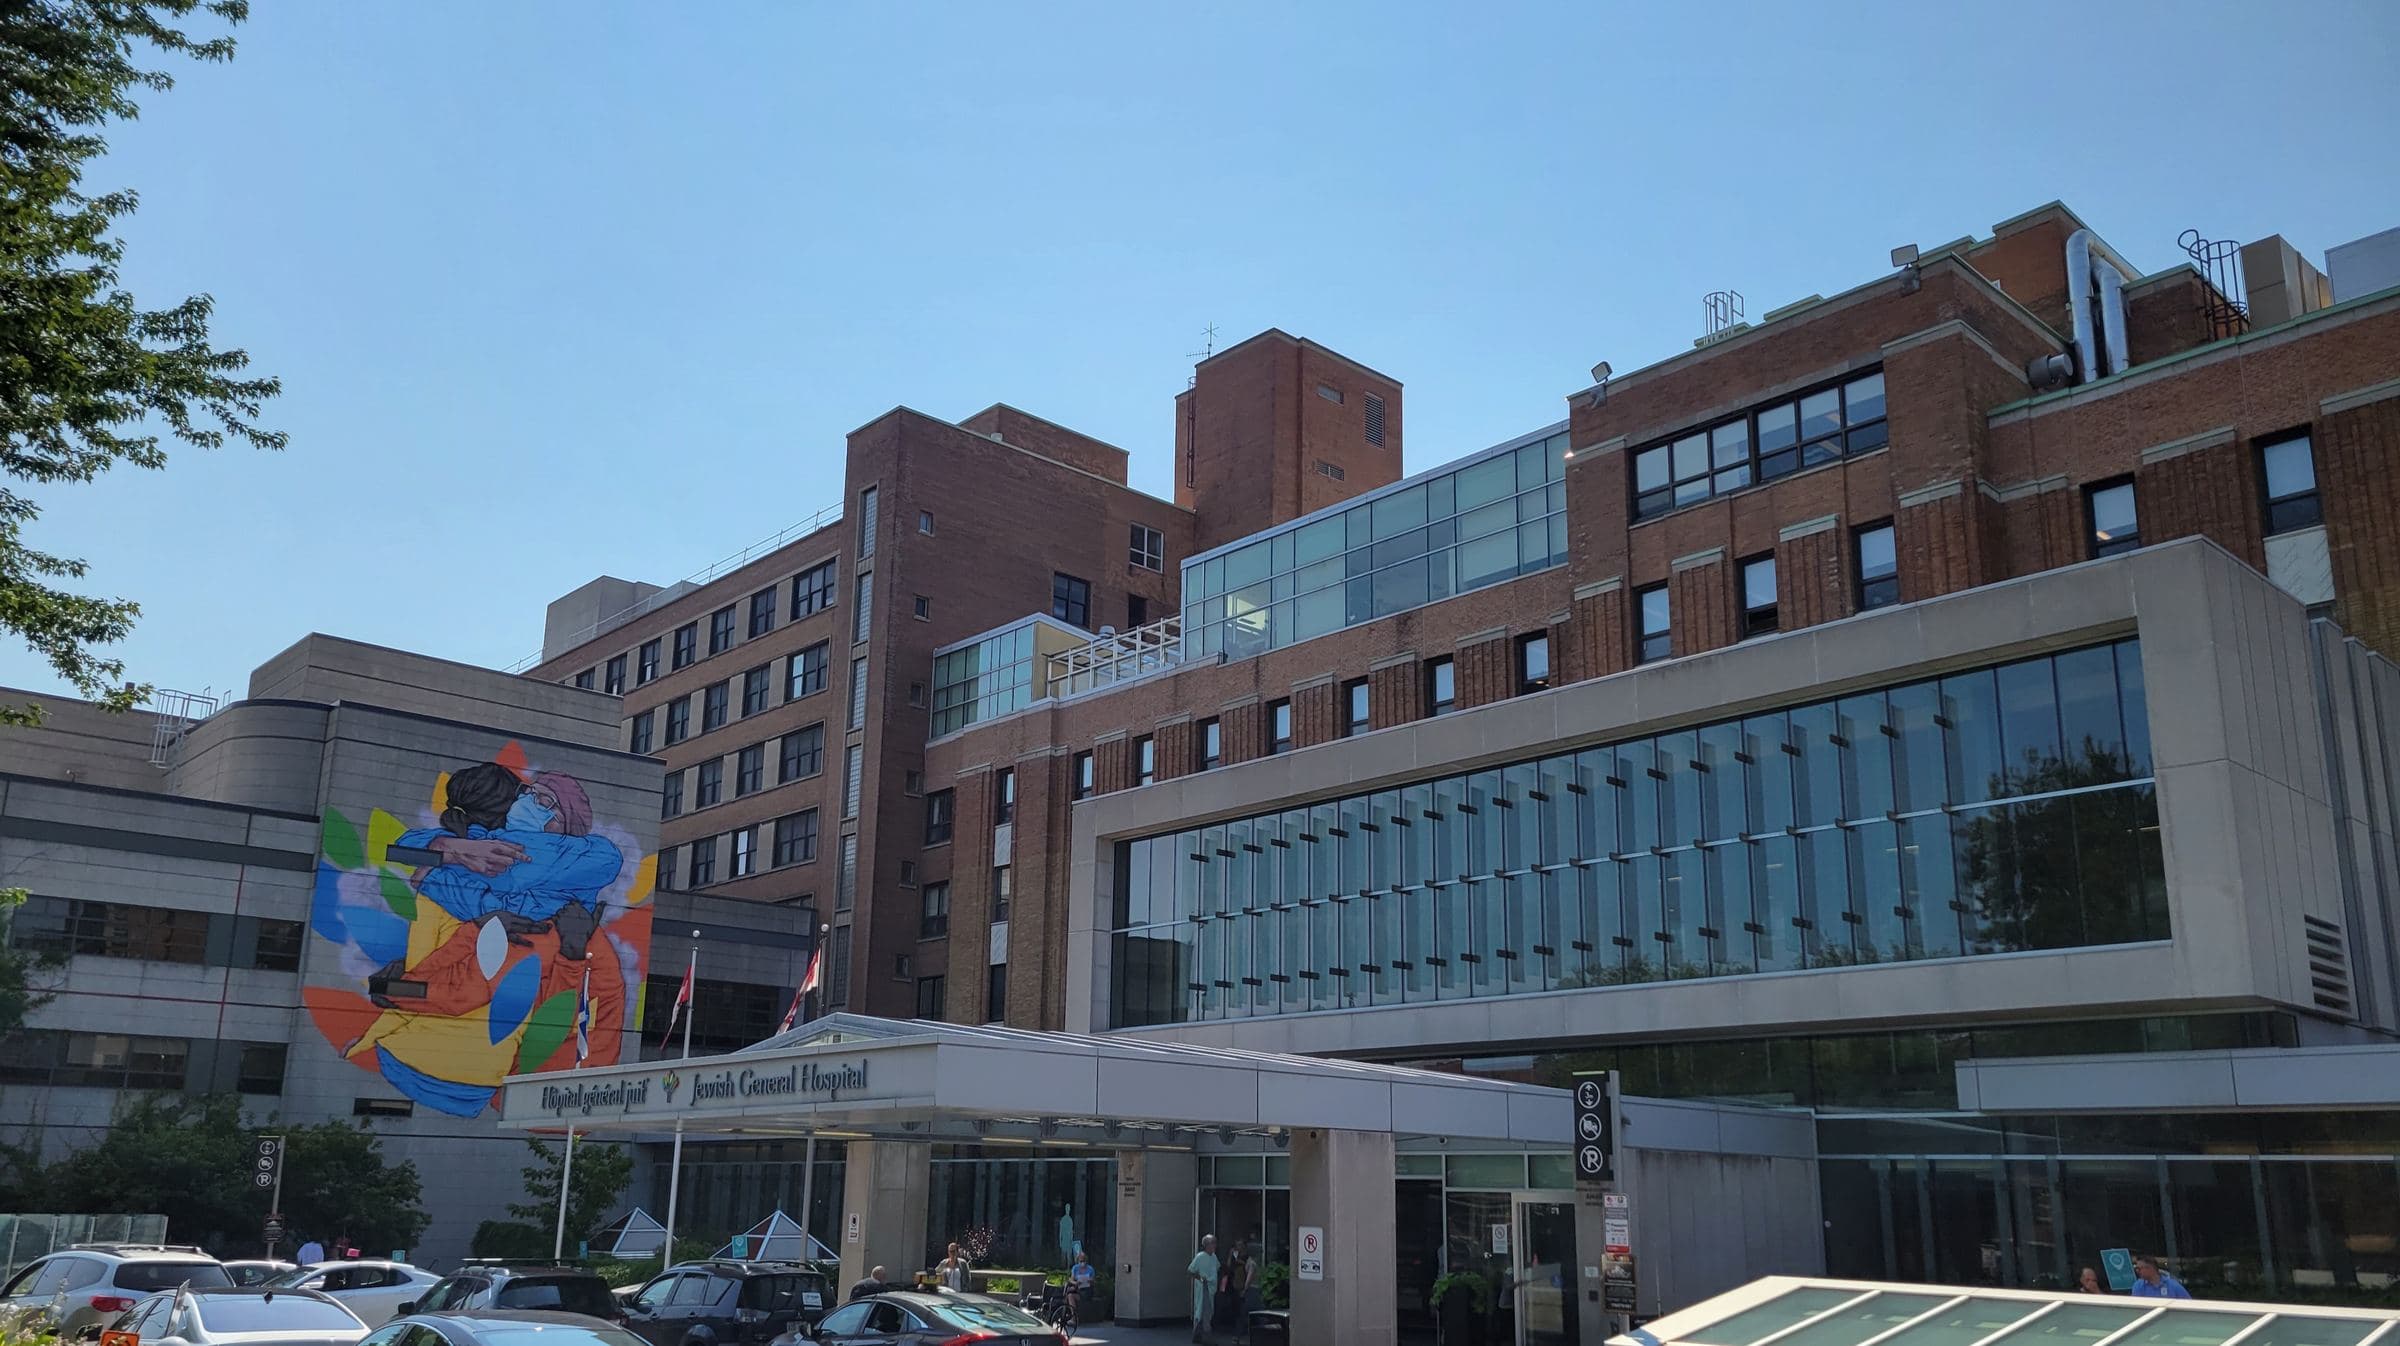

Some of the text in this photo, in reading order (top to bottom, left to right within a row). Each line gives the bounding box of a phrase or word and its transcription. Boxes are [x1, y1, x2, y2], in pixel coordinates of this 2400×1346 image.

[542, 1078, 649, 1117] Hôpital général juif
[690, 1058, 868, 1106] Jewish General Hospital
